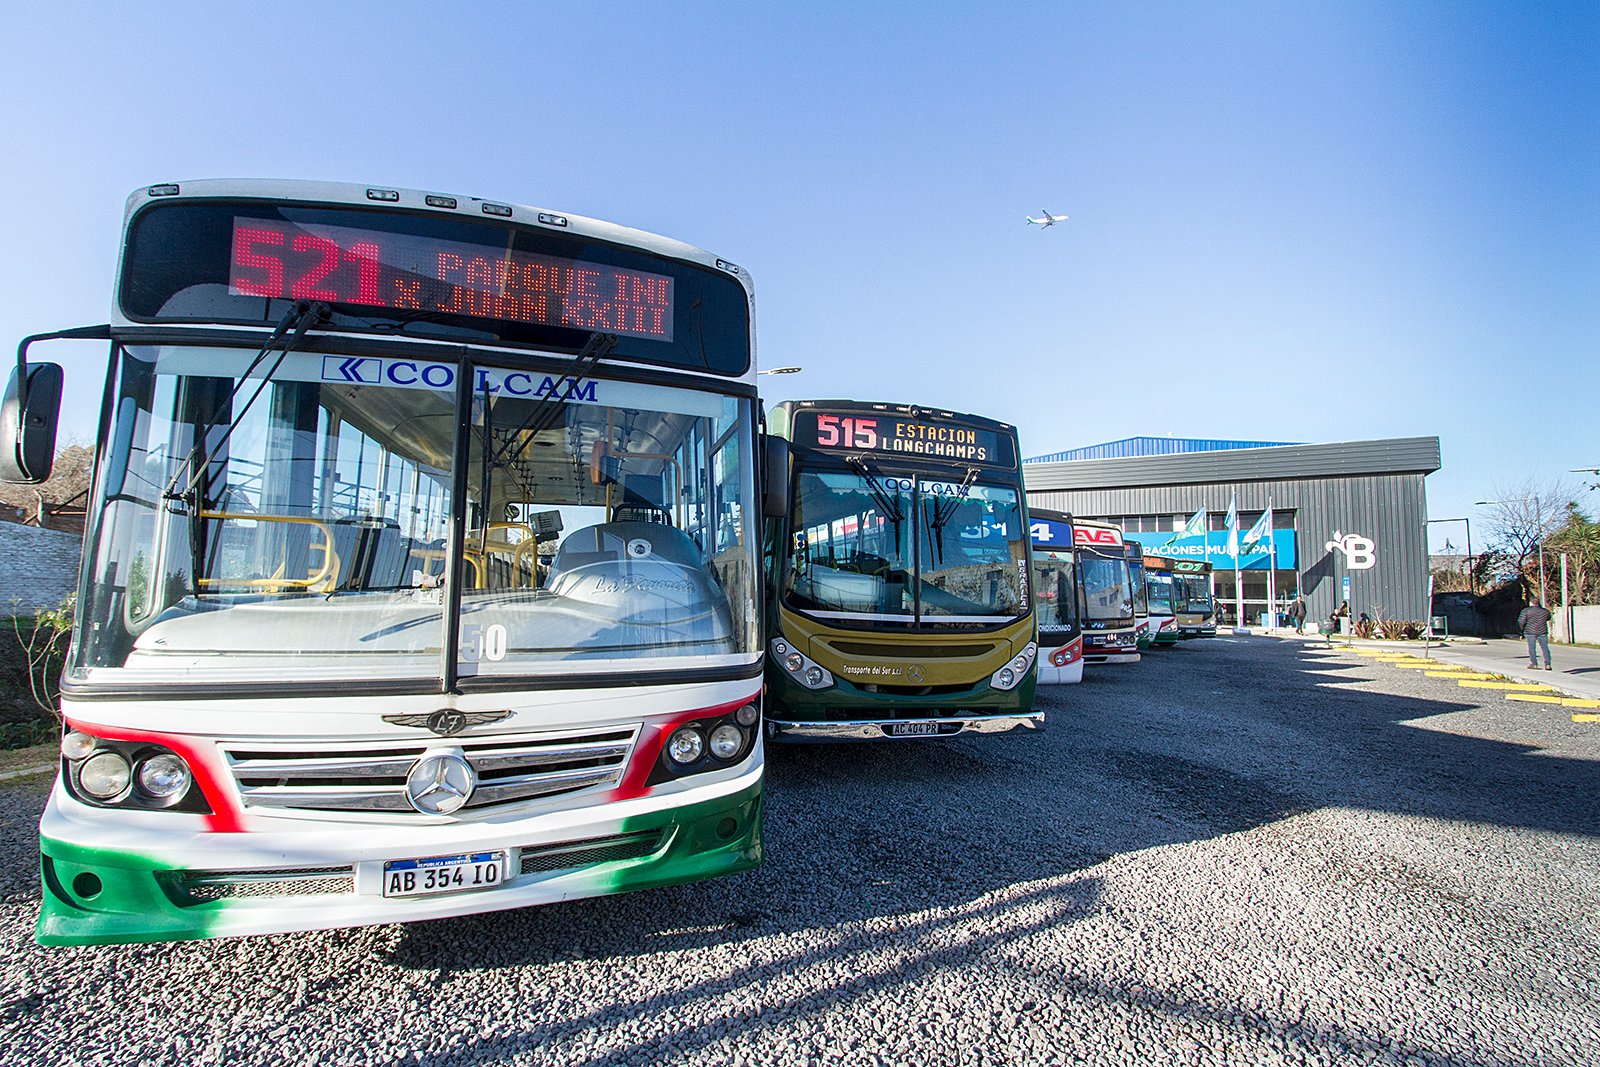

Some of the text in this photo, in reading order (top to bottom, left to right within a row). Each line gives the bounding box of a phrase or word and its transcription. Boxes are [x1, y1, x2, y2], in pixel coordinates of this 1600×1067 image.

[236, 227, 386, 306] 521
[437, 252, 601, 298] PARQUE
[436, 285, 547, 323] JUAN
[560, 297, 667, 335] XXIII
[817, 414, 877, 449] 515
[896, 423, 975, 444] ESTACION
[882, 437, 986, 461] LONGCHAMPS
[461, 624, 507, 661] 50
[843, 665, 871, 675] Transporte
[872, 666, 881, 675] del
[882, 667, 891, 675] Sur
[894, 724, 905, 734] AC
[907, 724, 923, 734] 404
[926, 724, 937, 734] PR
[389, 871, 416, 893] AB
[424, 867, 463, 889] 354
